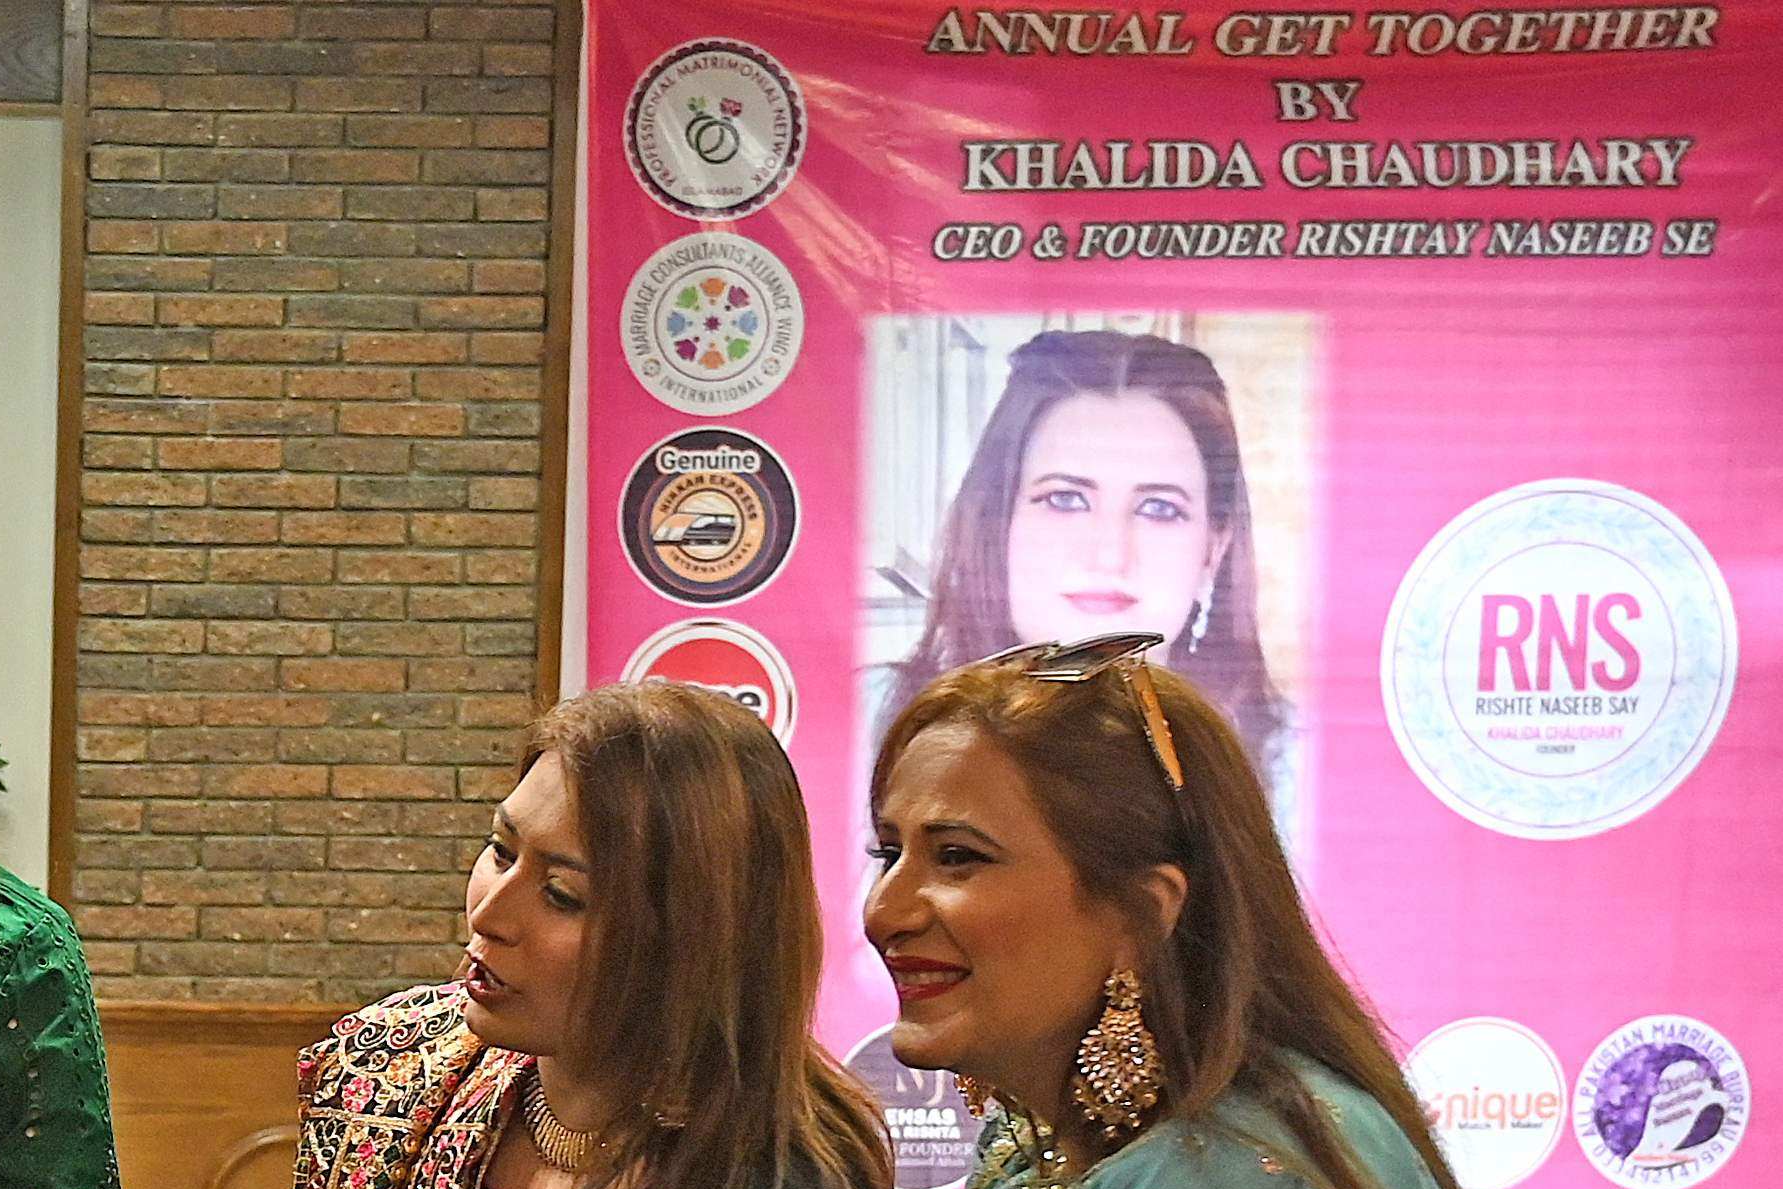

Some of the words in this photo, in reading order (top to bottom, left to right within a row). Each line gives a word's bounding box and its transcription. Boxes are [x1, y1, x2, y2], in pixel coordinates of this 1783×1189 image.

[926, 10, 1195, 54] ANNUAL
[1214, 11, 1351, 56] GET
[1368, 6, 1719, 56] TOGETHER
[1276, 80, 1360, 121] BY
[640, 77, 677, 187] PROFESSIONAL
[677, 57, 779, 104] MATRIMONIAL
[751, 108, 787, 186] NETWORK
[963, 140, 1264, 191] KHALIDA
[1281, 139, 1692, 190] CHAUDHARY
[932, 223, 1023, 260] CEO
[1032, 223, 1067, 260] &
[1078, 222, 1285, 259] FOUNDER
[1295, 221, 1479, 258] RISHTAY
[1485, 220, 1654, 258] NASEEB
[1662, 219, 1717, 257] SE
[631, 281, 658, 356] MARRIAGE
[650, 241, 746, 285] CONSULTANTS
[744, 255, 792, 311] ALLIANCE
[771, 317, 793, 356] WING
[659, 375, 764, 404] INTERNATIONAL
[659, 449, 757, 471] Genuine
[1477, 593, 1642, 693] RNS
[1475, 696, 1533, 716] RISHTE
[1540, 696, 1603, 716] NASEEB
[1609, 696, 1640, 716] SAY
[1580, 1028, 1644, 1097] PAKISTAN
[1652, 1024, 1733, 1068] MARRIAGE
[1720, 1070, 1744, 1142] BUREAU
[884, 1108, 956, 1125] EHSAS
[902, 1126, 961, 1139] RISHTA
